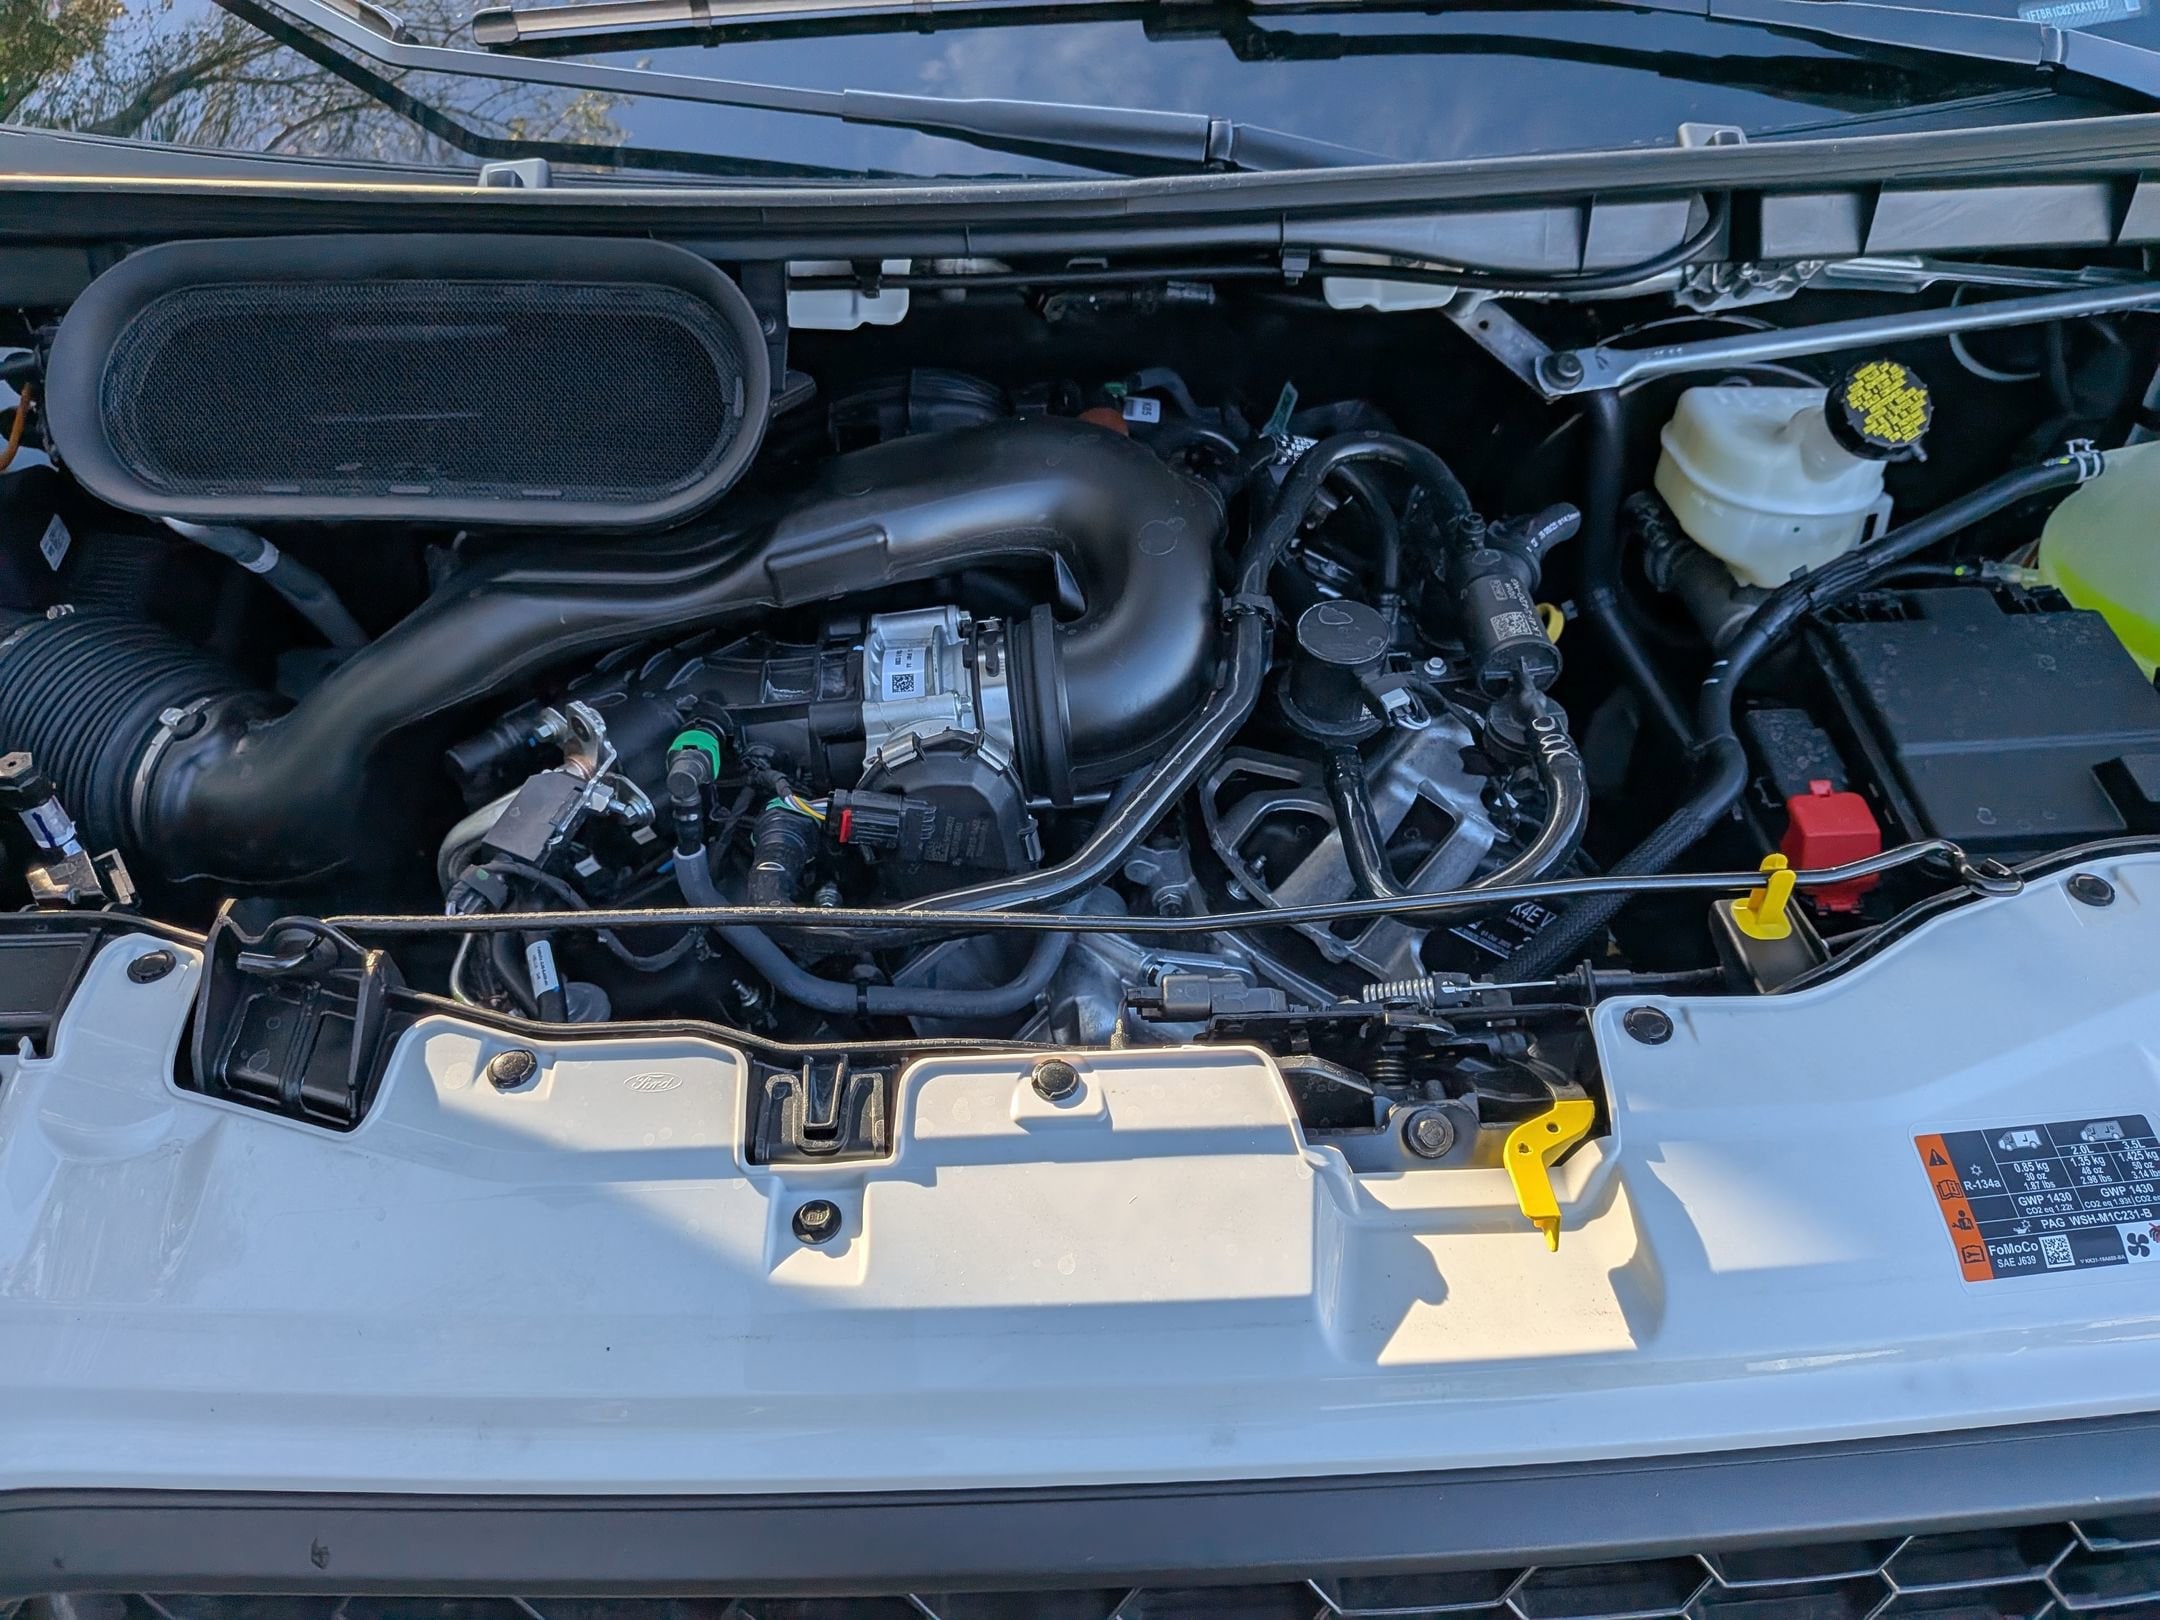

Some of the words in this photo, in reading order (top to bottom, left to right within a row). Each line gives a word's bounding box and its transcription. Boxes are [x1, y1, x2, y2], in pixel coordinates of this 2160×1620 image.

[2070, 1144, 2095, 1155] 2.0L
[2121, 1139, 2146, 1150] 3.5L
[2070, 1155, 2091, 1167] 1.35
[2091, 1155, 2106, 1167] kg
[2118, 1150, 2145, 1162] 1.425
[2144, 1149, 2160, 1161] kg
[2013, 1161, 2035, 1173] 0.85
[2035, 1160, 2050, 1173] kg
[2081, 1166, 2092, 1175] 48
[2131, 1161, 2142, 1170] 50
[2024, 1172, 2035, 1181] 30
[2080, 1174, 2098, 1185] 2.98
[2098, 1174, 2113, 1183] lbs
[2131, 1169, 2149, 1180] 3.14
[1963, 1178, 2001, 1191] R-134a
[2024, 1181, 2040, 1191] 1.87
[2041, 1180, 2056, 1189] lbs
[2100, 1185, 2126, 1197] GWP
[2129, 1183, 2154, 1195] 1430
[2018, 1194, 2044, 1206] GWP
[2047, 1191, 2073, 1203] 1430
[2134, 1195, 2153, 1203] CO2
[2026, 1206, 2043, 1215] CO2
[2044, 1206, 2055, 1214] eq
[2055, 1203, 2074, 1213] 1.22t
[2084, 1200, 2102, 1209] CO2
[2102, 1200, 2114, 1208] eq
[2040, 1217, 2066, 1230] PAG
[2068, 1208, 2153, 1226] WSH-M1C231-B
[1987, 1241, 2039, 1256] FoMoCo
[1997, 1258, 2016, 1268] SAE
[2018, 1255, 2037, 1266] J639
